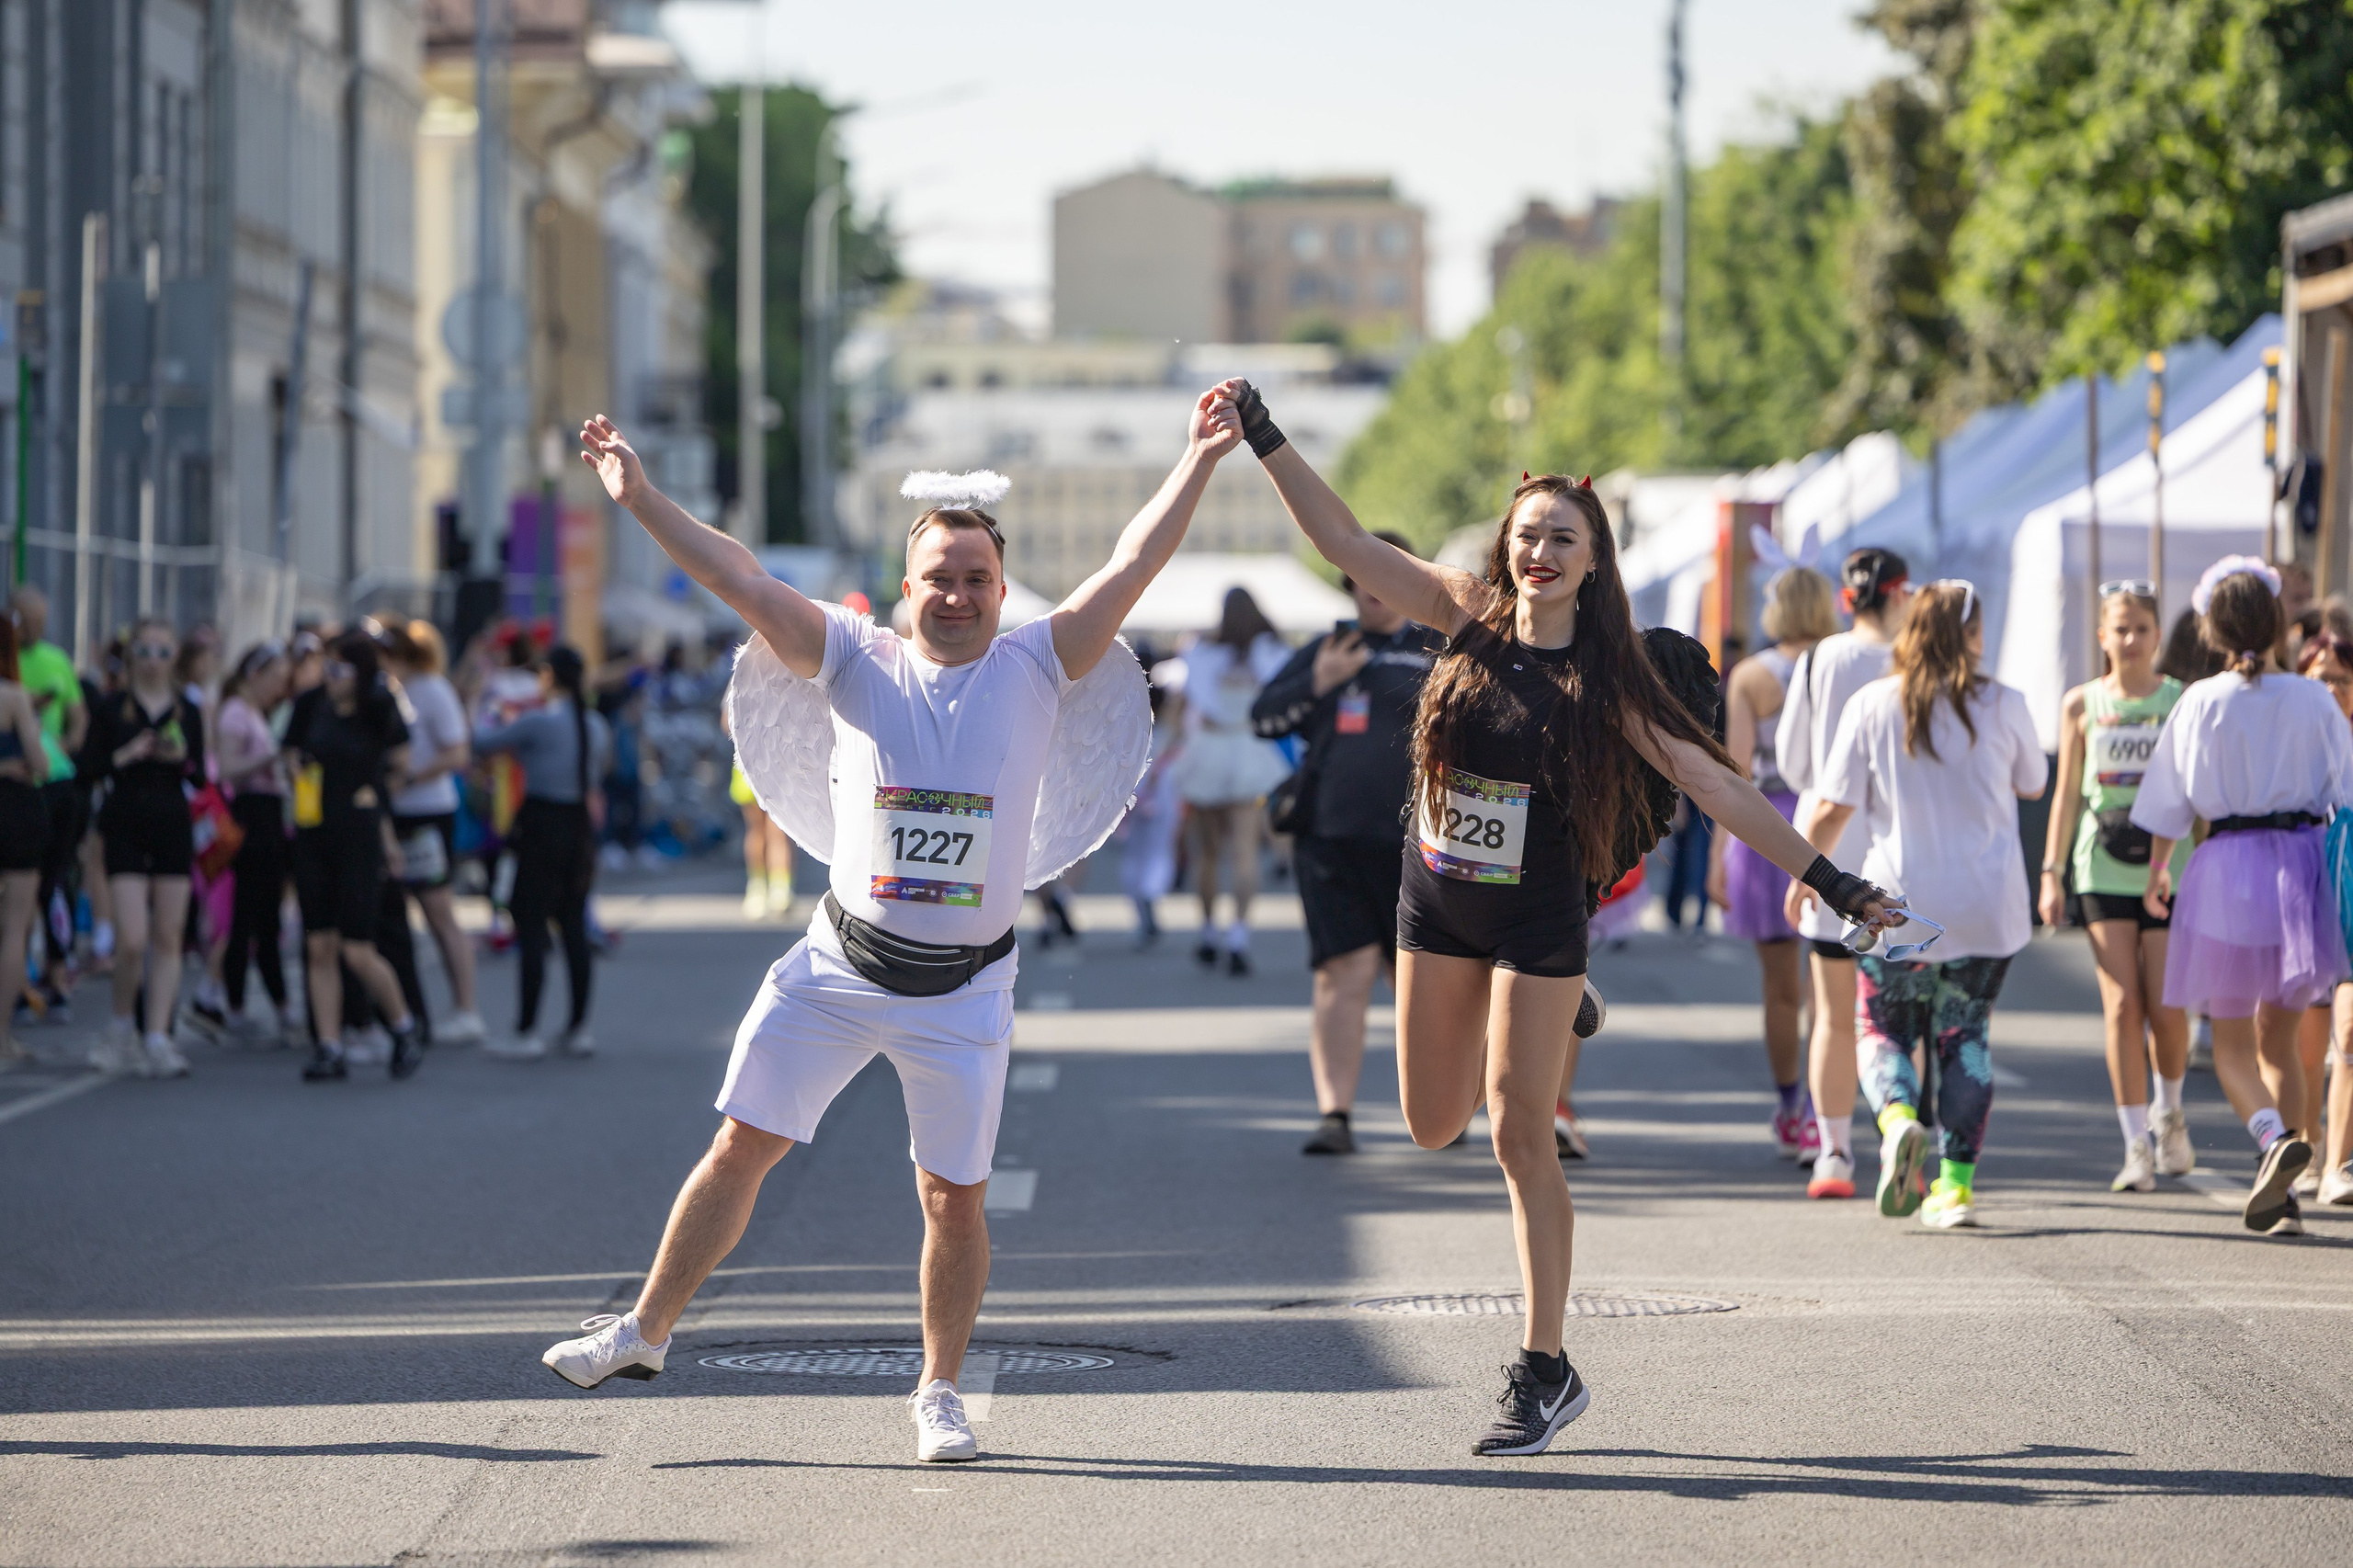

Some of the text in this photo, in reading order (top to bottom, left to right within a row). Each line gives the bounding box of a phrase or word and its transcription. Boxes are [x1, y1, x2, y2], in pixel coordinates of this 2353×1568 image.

[2109, 736, 2158, 762] 690
[1448, 769, 1519, 797] АСОЧНЫЙ
[885, 788, 985, 809] КРАСОЧНЫЙ
[1475, 792, 1527, 807] 2026
[941, 806, 991, 819] 2026
[1442, 807, 1506, 849] 228
[891, 826, 974, 866] 1227
